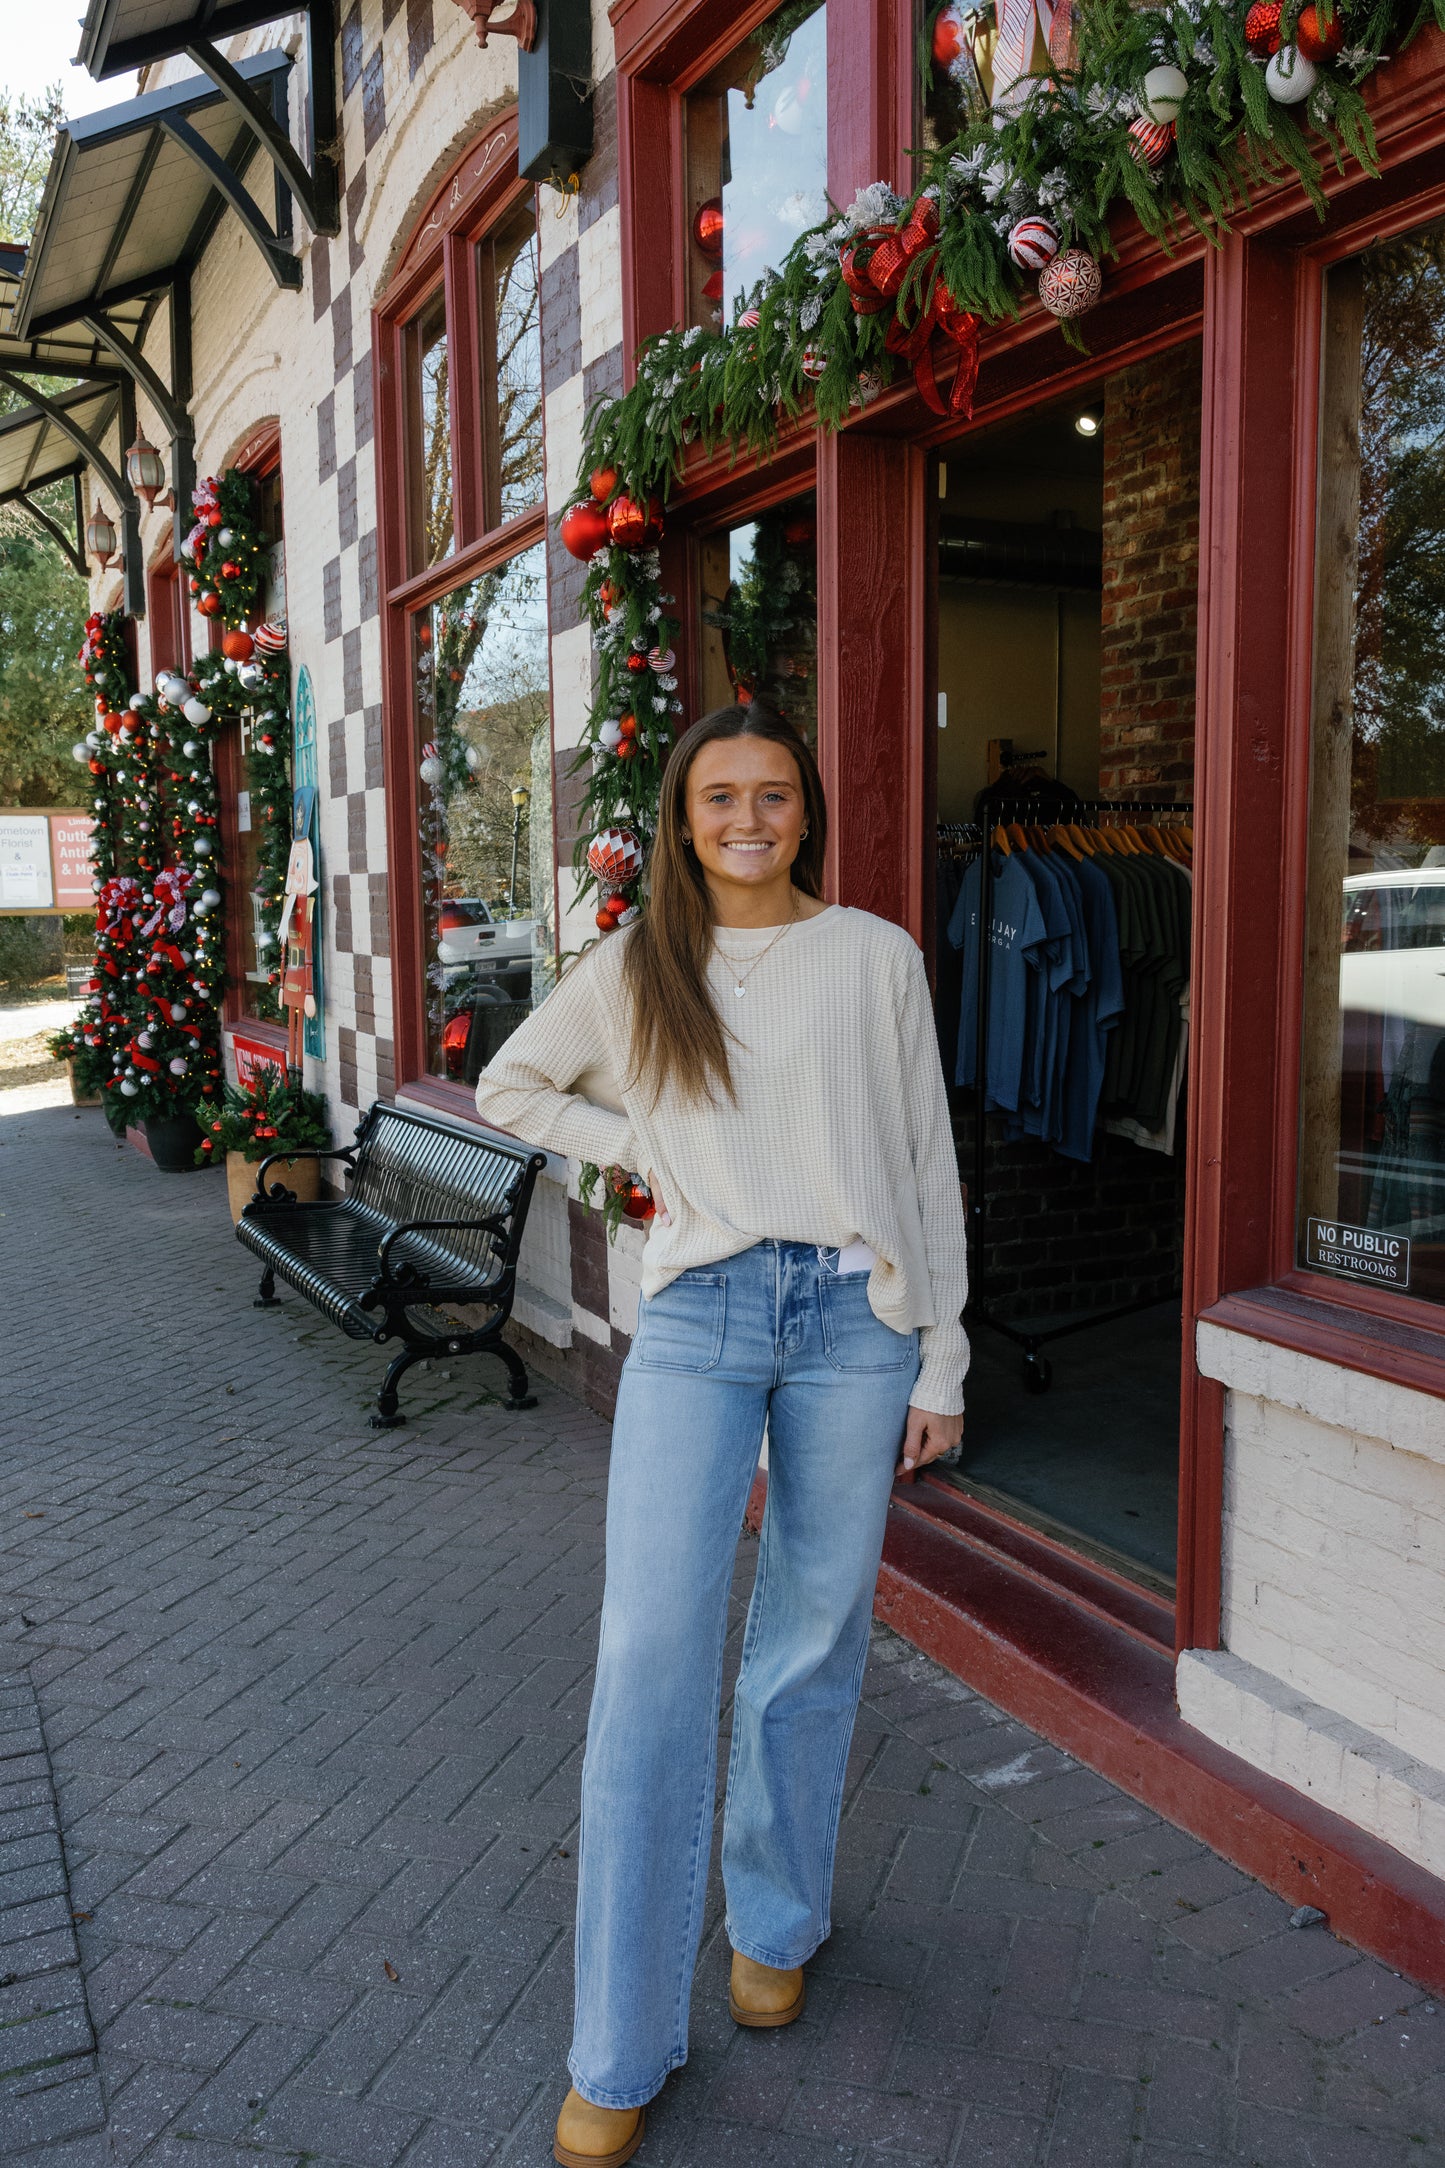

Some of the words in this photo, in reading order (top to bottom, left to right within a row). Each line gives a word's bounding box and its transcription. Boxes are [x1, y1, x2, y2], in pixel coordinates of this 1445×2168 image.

[1, 839, 33, 848] Florist
[14, 852, 21, 861] &
[62, 863, 72, 875] &
[971, 912, 1017, 940] EIJAY
[1317, 1225, 1336, 1243] NO
[1343, 1230, 1400, 1257] PUBLIC
[1318, 1249, 1397, 1278] RESTROOMS
